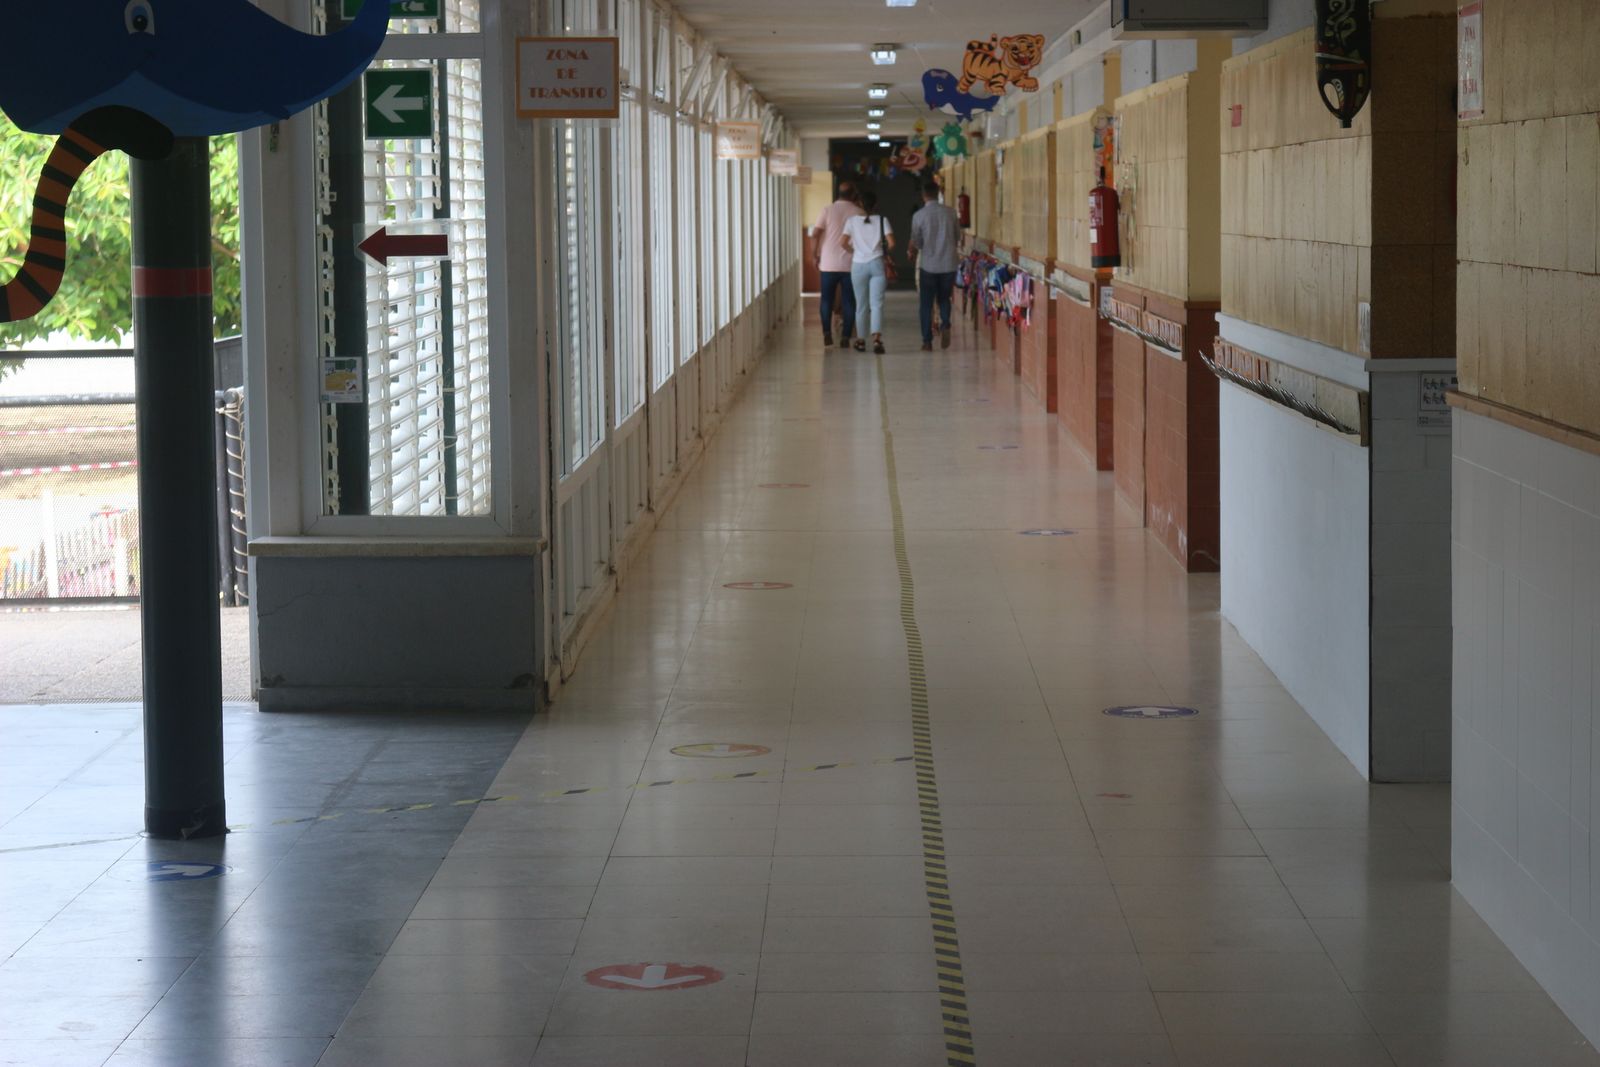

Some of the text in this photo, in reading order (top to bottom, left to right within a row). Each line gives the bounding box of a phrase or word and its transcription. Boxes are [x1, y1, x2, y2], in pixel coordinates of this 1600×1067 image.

[546, 48, 591, 60] ZONA
[556, 68, 577, 79] DE
[528, 87, 607, 98] TRANSITO
